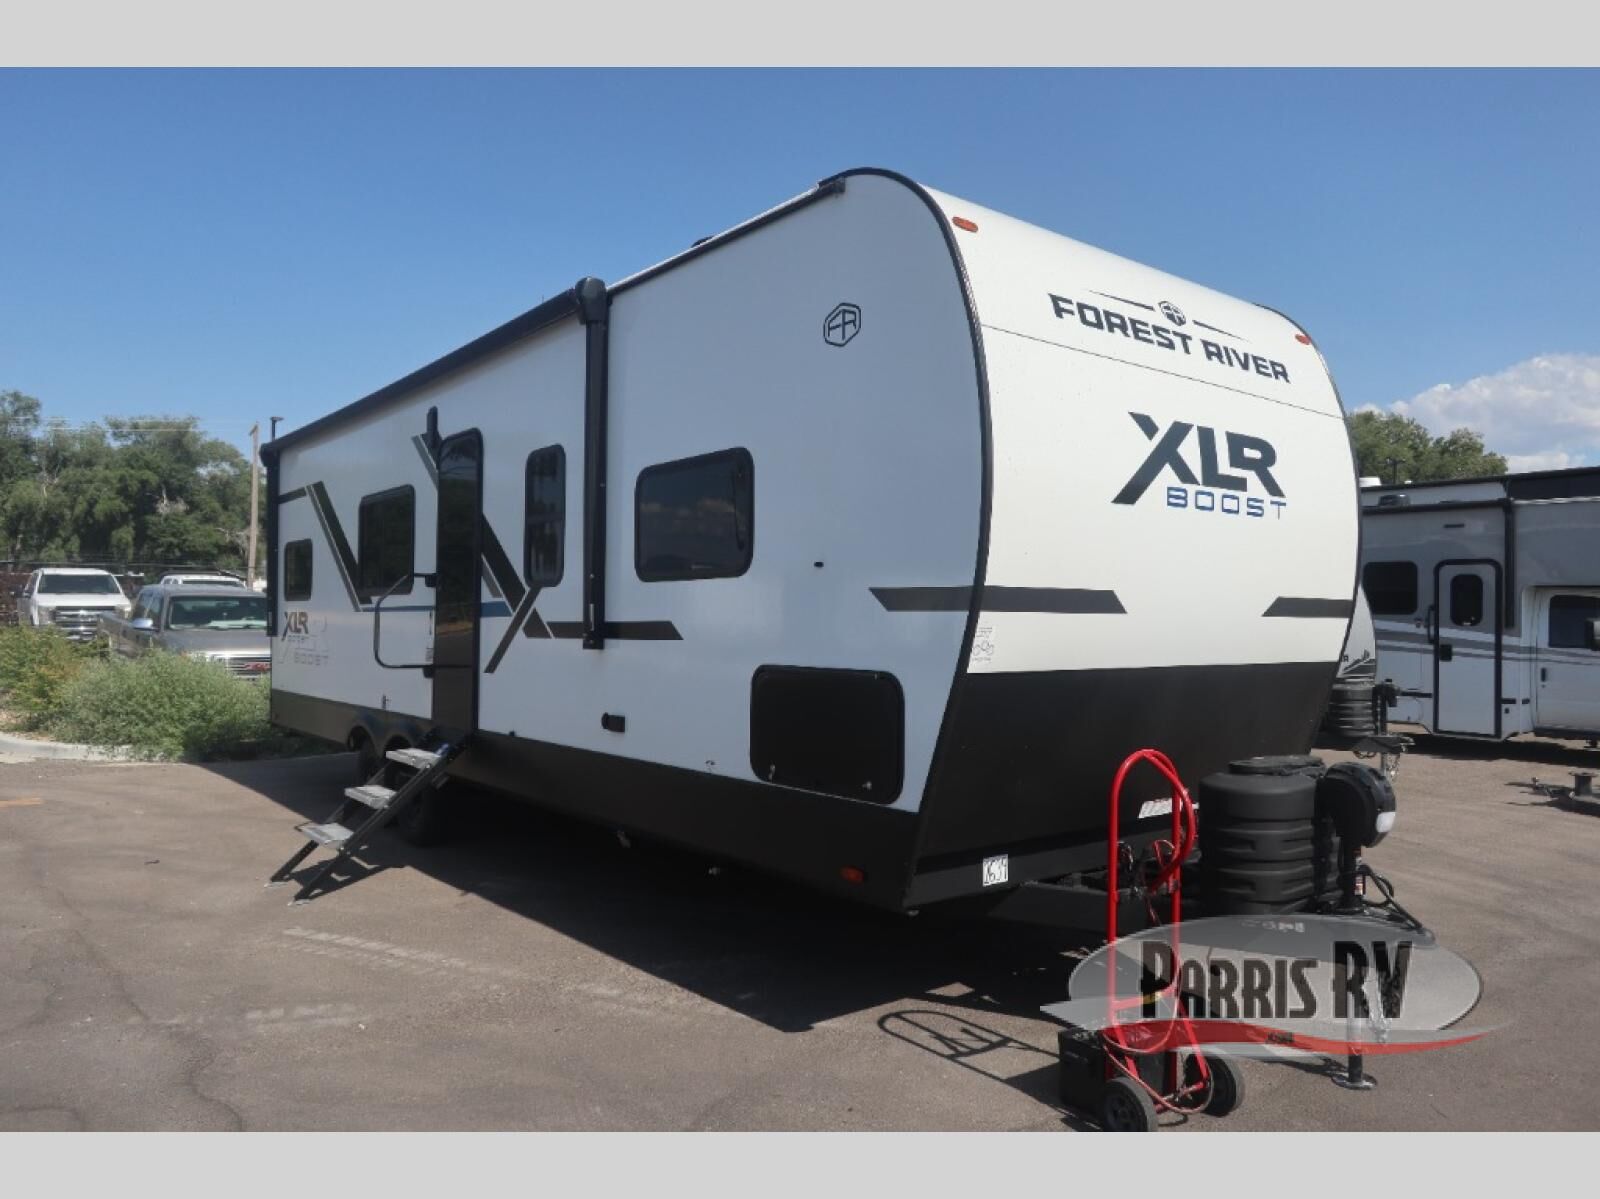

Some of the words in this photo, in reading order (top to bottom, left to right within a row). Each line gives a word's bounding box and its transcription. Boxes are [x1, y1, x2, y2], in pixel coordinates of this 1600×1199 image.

[1048, 293, 1192, 355] FOREST
[1200, 338, 1291, 383] RIVER
[1111, 411, 1286, 505] XLR
[1166, 486, 1287, 519] BOOST
[282, 611, 309, 641] XLR
